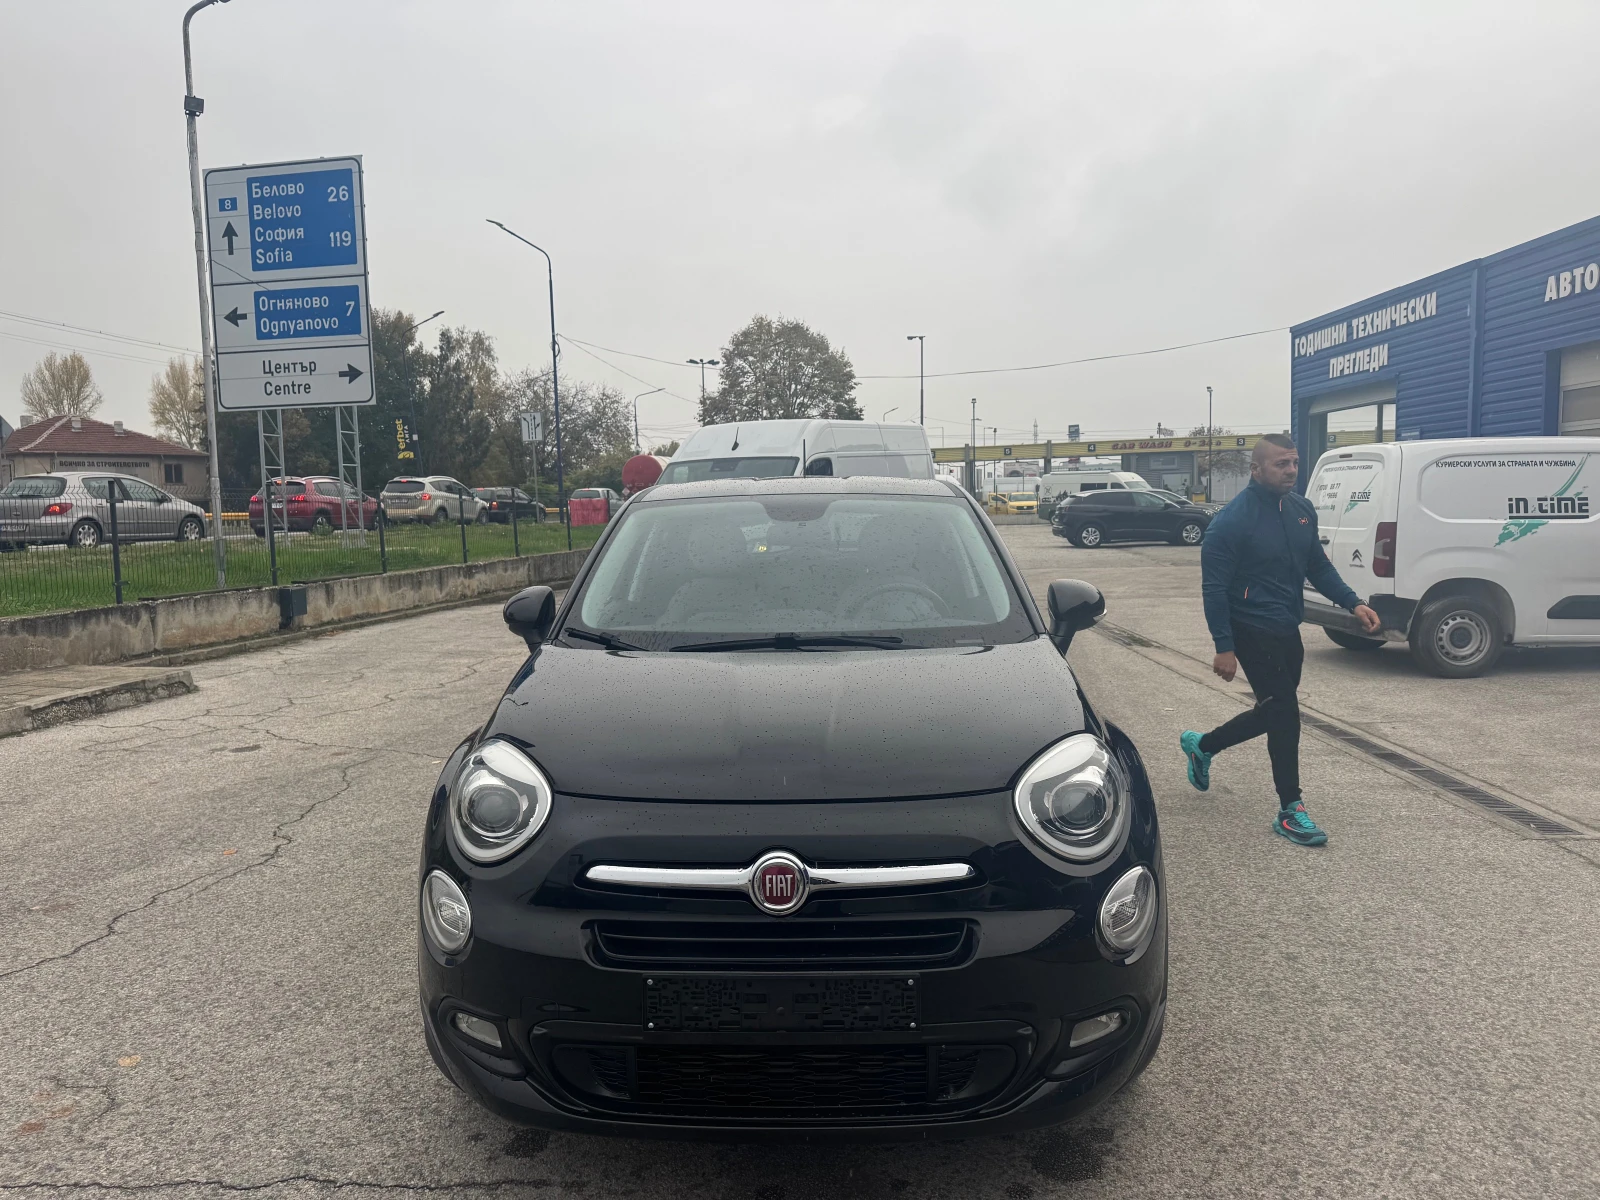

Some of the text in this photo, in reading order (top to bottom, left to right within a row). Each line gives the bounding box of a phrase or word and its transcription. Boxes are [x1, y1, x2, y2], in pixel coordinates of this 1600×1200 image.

[252, 182, 305, 199] Белово
[327, 185, 349, 202] 26
[224, 200, 232, 210] 8
[253, 204, 302, 220] Belovo
[254, 227, 305, 244] София
[329, 231, 352, 248] 119
[255, 248, 293, 264] Sofia
[1544, 263, 1599, 302] АВТО
[259, 295, 329, 312] Огняново
[345, 301, 355, 317] 7
[260, 316, 339, 336] Ognyanovo
[1295, 291, 1437, 357] ГОДИШНИ ТЕХНИЧЕСКИ
[262, 358, 317, 377] Център
[1329, 343, 1389, 379] ПРЕГЛЕДИ
[264, 381, 312, 397] Centre
[395, 418, 406, 450] efbet
[1111, 442, 1136, 450] CAR
[1139, 441, 1173, 449] WASH
[765, 874, 794, 897] FIAT
